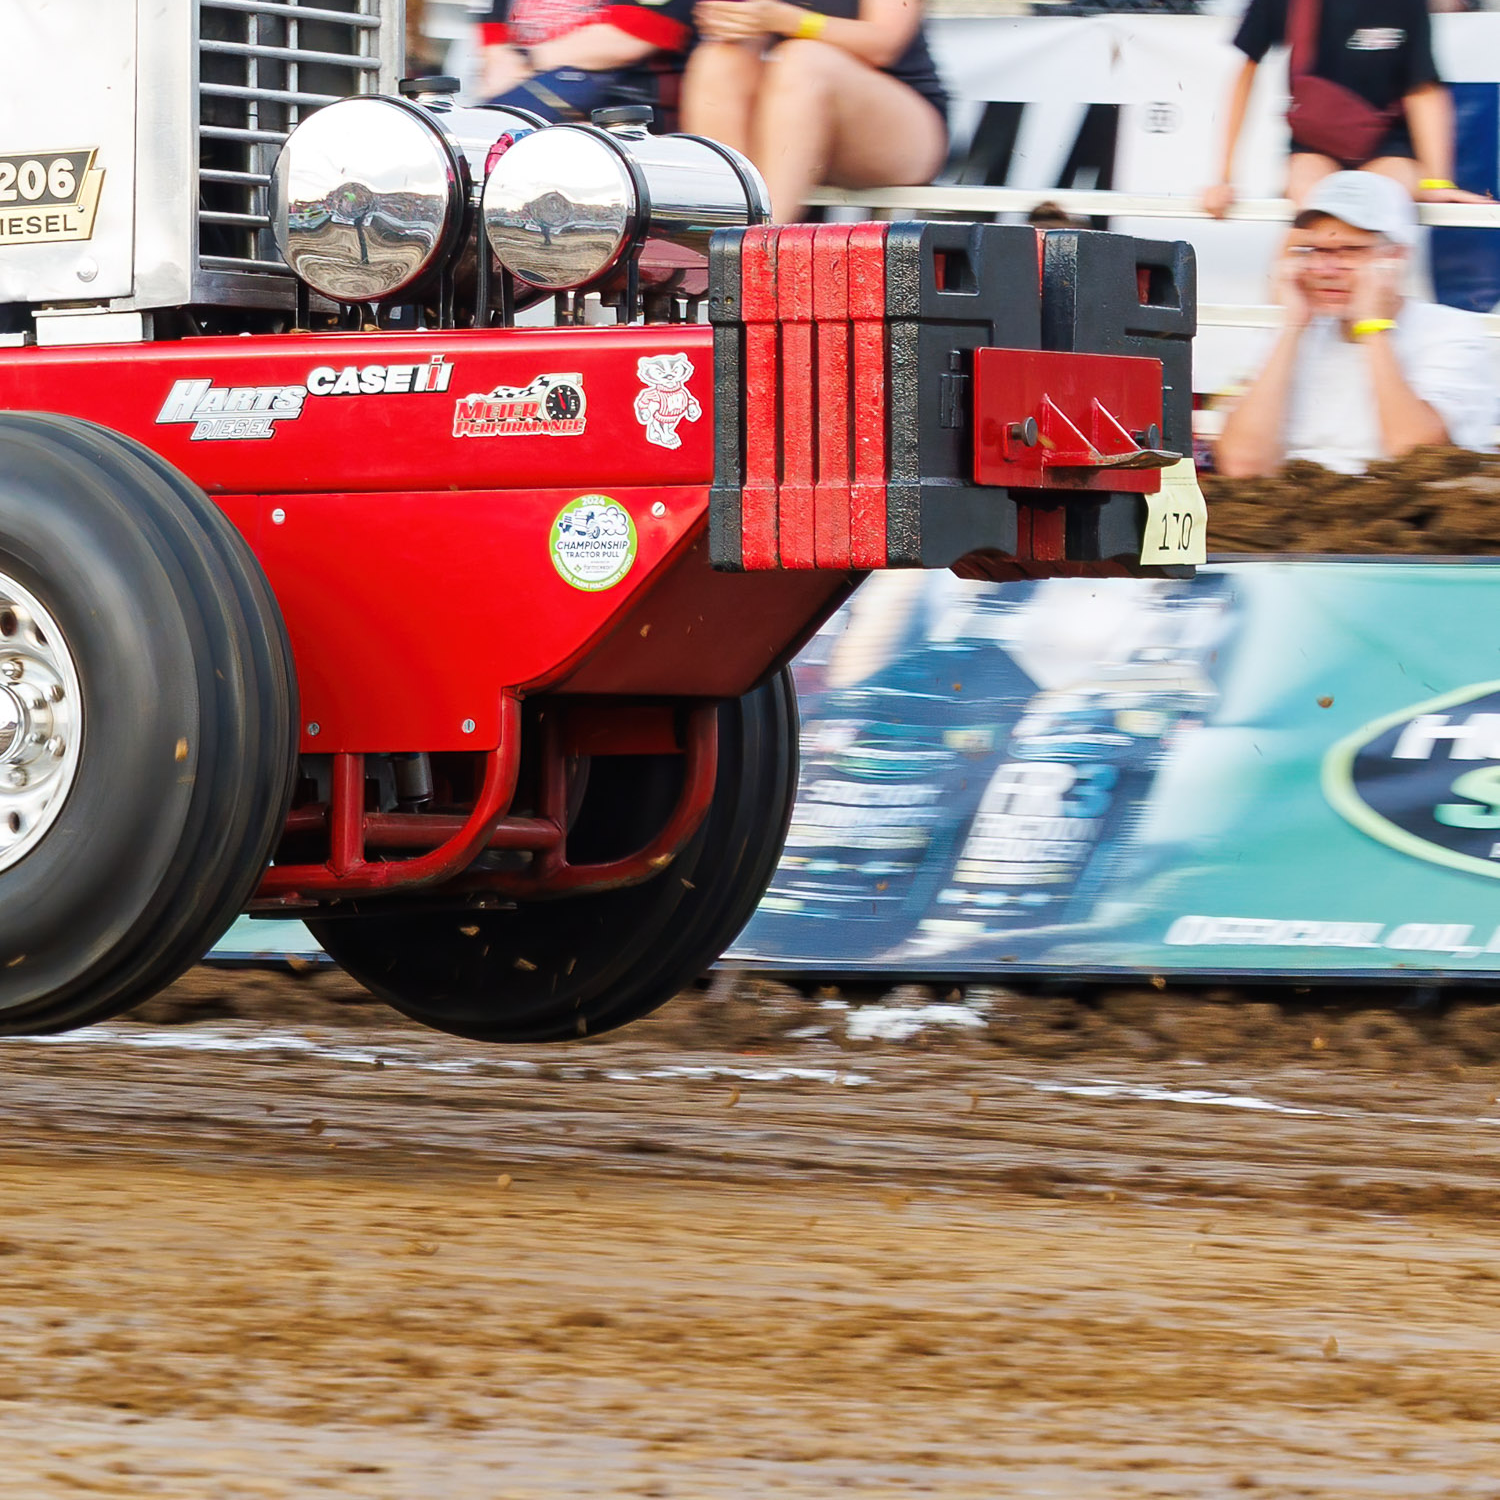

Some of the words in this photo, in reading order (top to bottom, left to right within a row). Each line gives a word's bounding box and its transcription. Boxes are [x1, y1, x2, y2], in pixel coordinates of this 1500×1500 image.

[157, 379, 308, 422] HARTS
[457, 401, 541, 420] MEIER
[193, 417, 274, 439] DIESEL
[454, 419, 584, 435] PERFORMANCE
[556, 540, 629, 550] CHAMPIONSHIP
